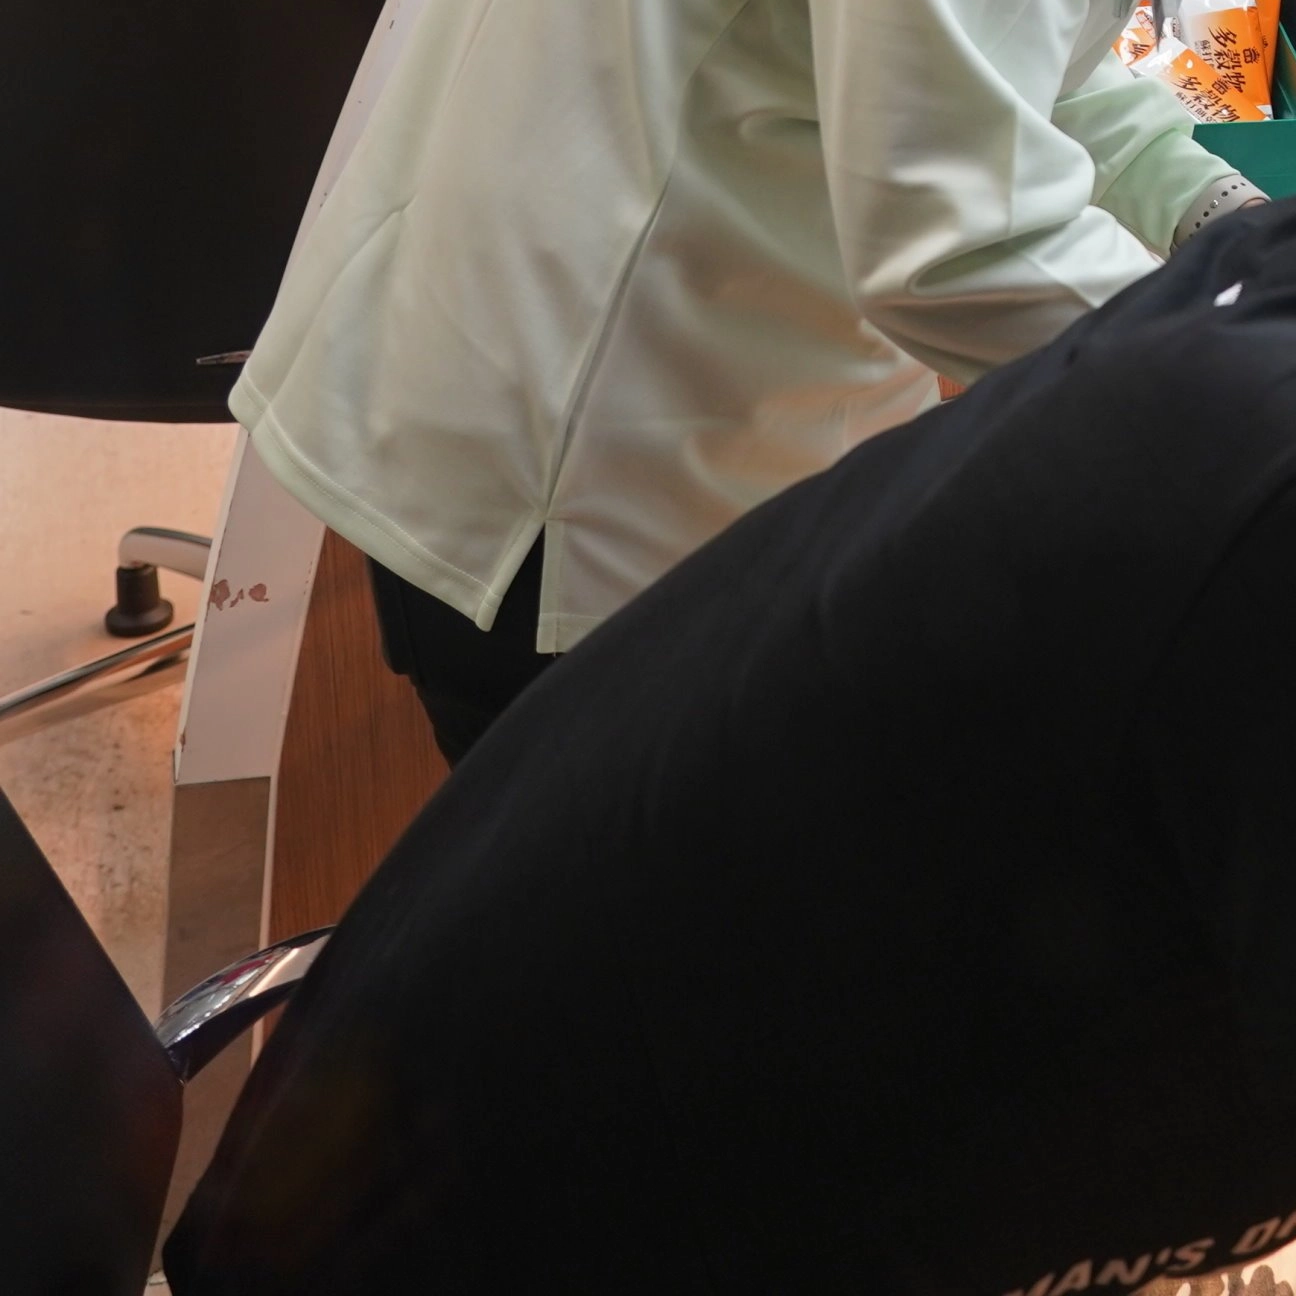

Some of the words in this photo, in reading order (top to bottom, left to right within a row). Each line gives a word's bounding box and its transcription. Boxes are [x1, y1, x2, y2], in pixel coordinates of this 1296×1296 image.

[1207, 25, 1247, 93] 多穀物
[1170, 75, 1241, 122] 多穀物
